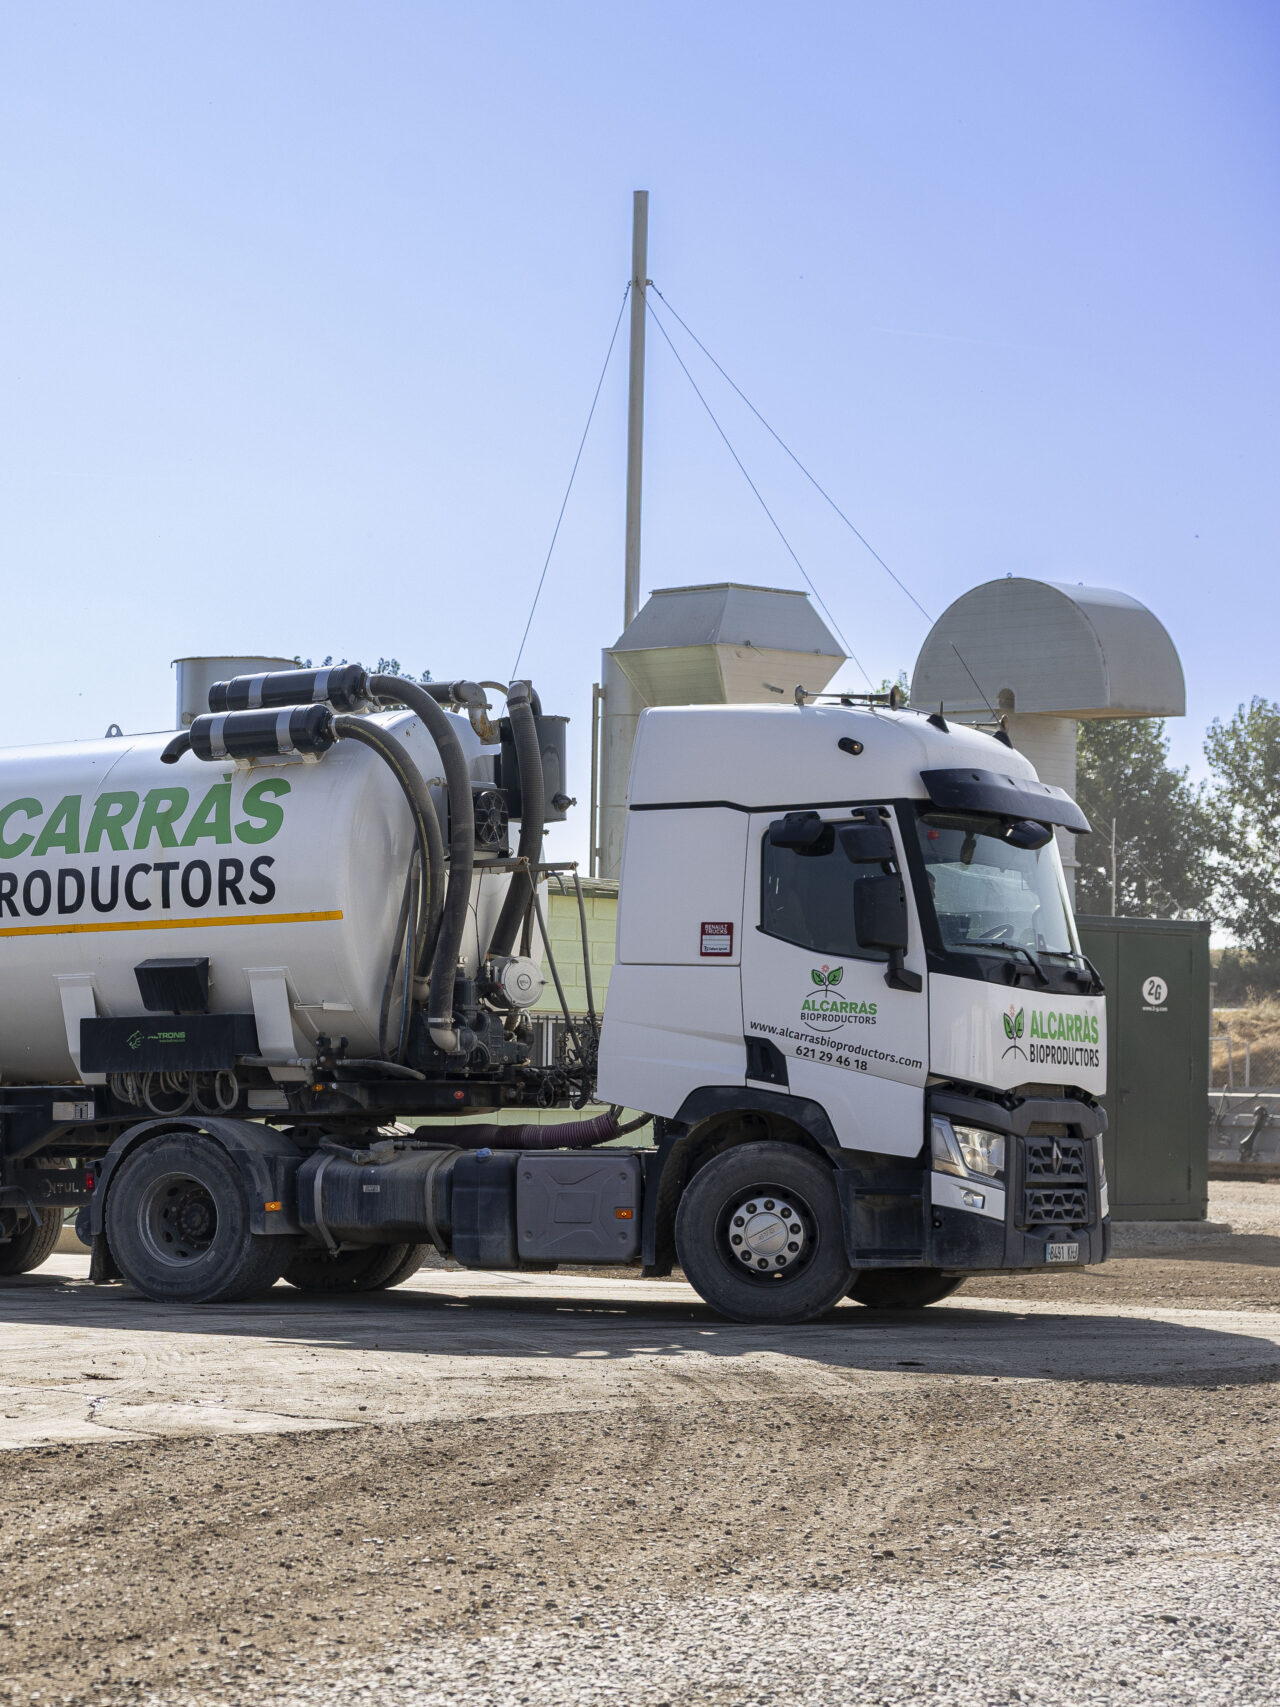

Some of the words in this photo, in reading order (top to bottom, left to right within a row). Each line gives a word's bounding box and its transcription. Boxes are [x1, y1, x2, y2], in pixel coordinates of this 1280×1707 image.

[1147, 980, 1162, 1001] 2G
[800, 1012, 877, 1025] BIOPRODUCTORS
[750, 1021, 923, 1069] www.alcarrasbioproductors.com
[795, 1045, 816, 1059] 621
[819, 1050, 833, 1063] 29
[836, 1055, 851, 1067] 46
[854, 1059, 868, 1071] 18
[1030, 1043, 1100, 1069] BIOPRODUCTORS
